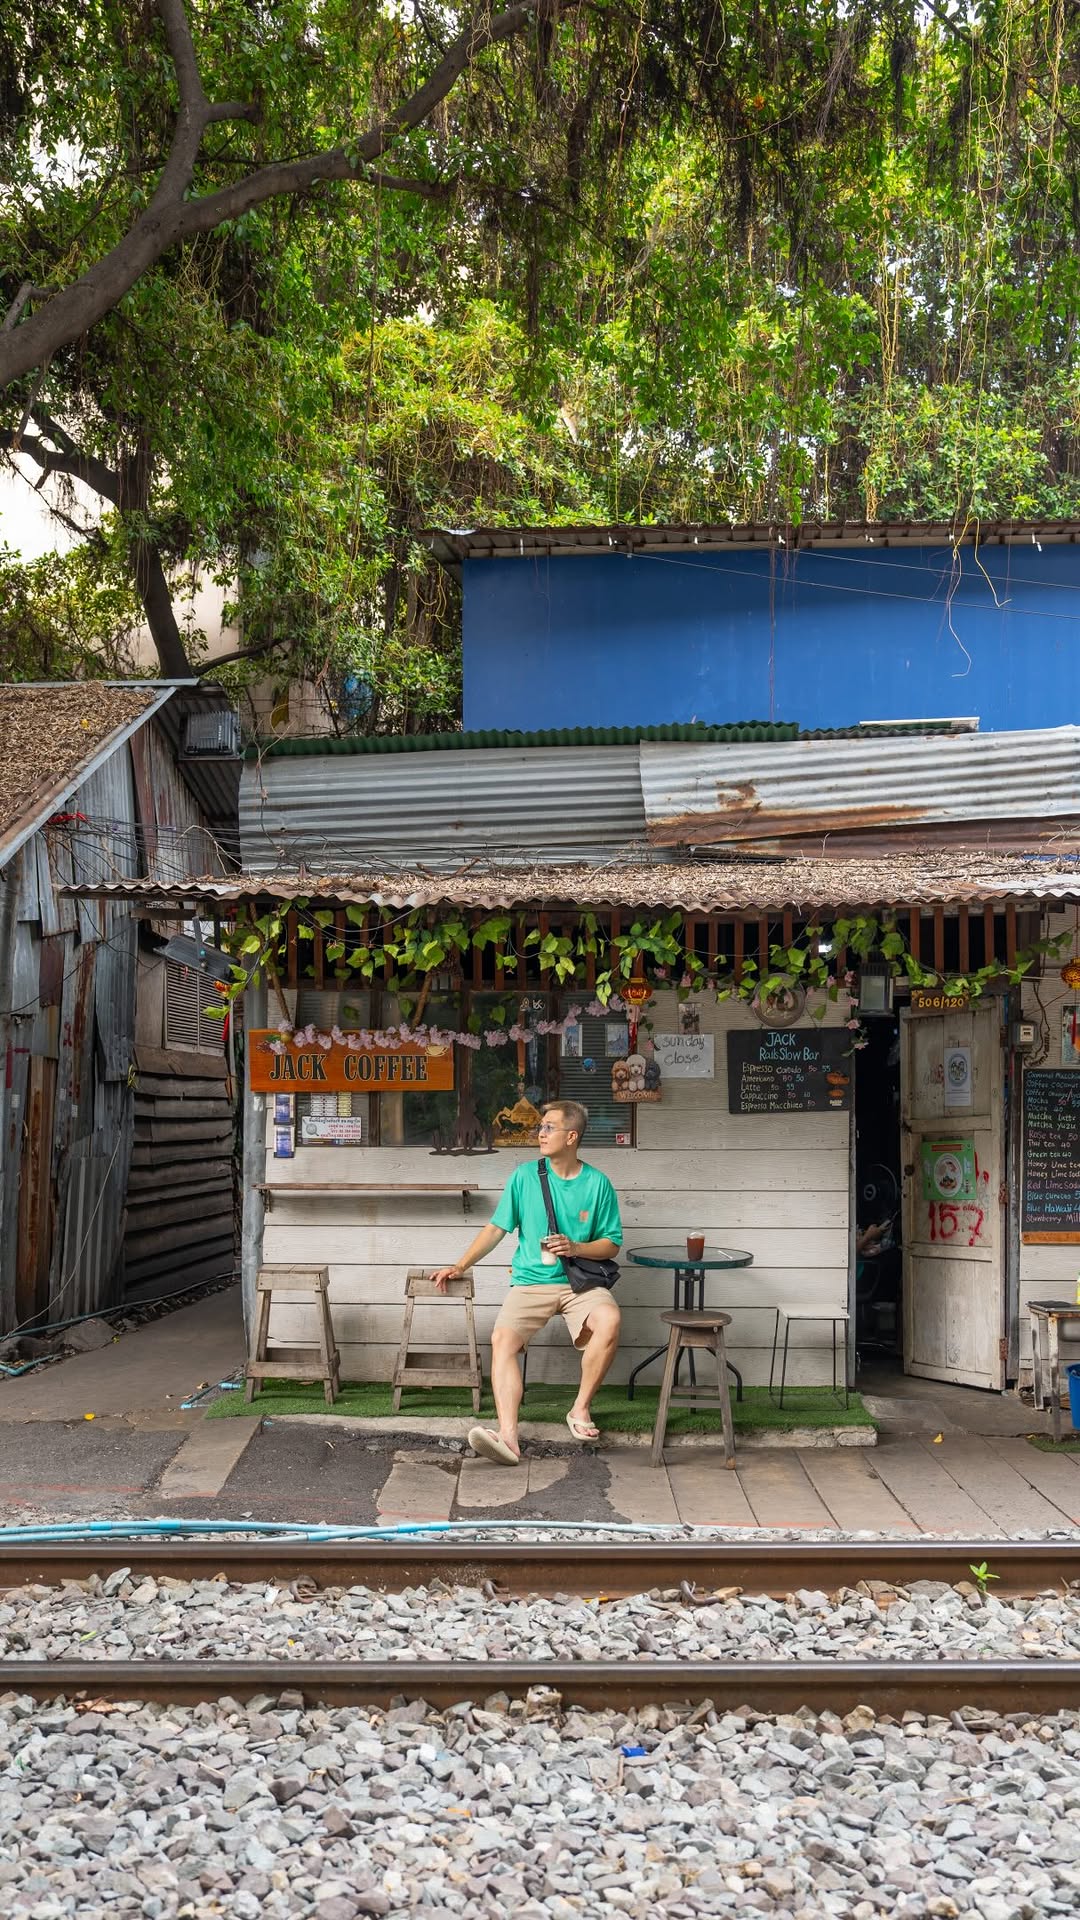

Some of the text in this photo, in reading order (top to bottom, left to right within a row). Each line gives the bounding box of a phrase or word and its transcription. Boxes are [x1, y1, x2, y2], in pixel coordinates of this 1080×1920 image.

[918, 996, 964, 1009] 506/120
[766, 1032, 796, 1047] JACK
[803, 1047, 819, 1061] Bar
[269, 1053, 429, 1081] JACK COFFEE
[742, 1062, 773, 1074] Espresso
[741, 1074, 775, 1083] Americano
[741, 1084, 761, 1093] Latte
[740, 1091, 779, 1101] Cappuccino
[741, 1101, 767, 1111] Espresso
[1061, 1141, 1071, 1149] 40
[1027, 1150, 1047, 1158] Green
[1027, 1160, 1047, 1170] Honey
[1027, 1169, 1048, 1179] Honey
[1051, 1169, 1067, 1178] Lime
[1026, 1180, 1041, 1190] Red
[1045, 1180, 1063, 1190] Lime
[1027, 1190, 1043, 1201] Blue
[1026, 1203, 1041, 1212] Blue
[1044, 1203, 1072, 1213] Hawaii
